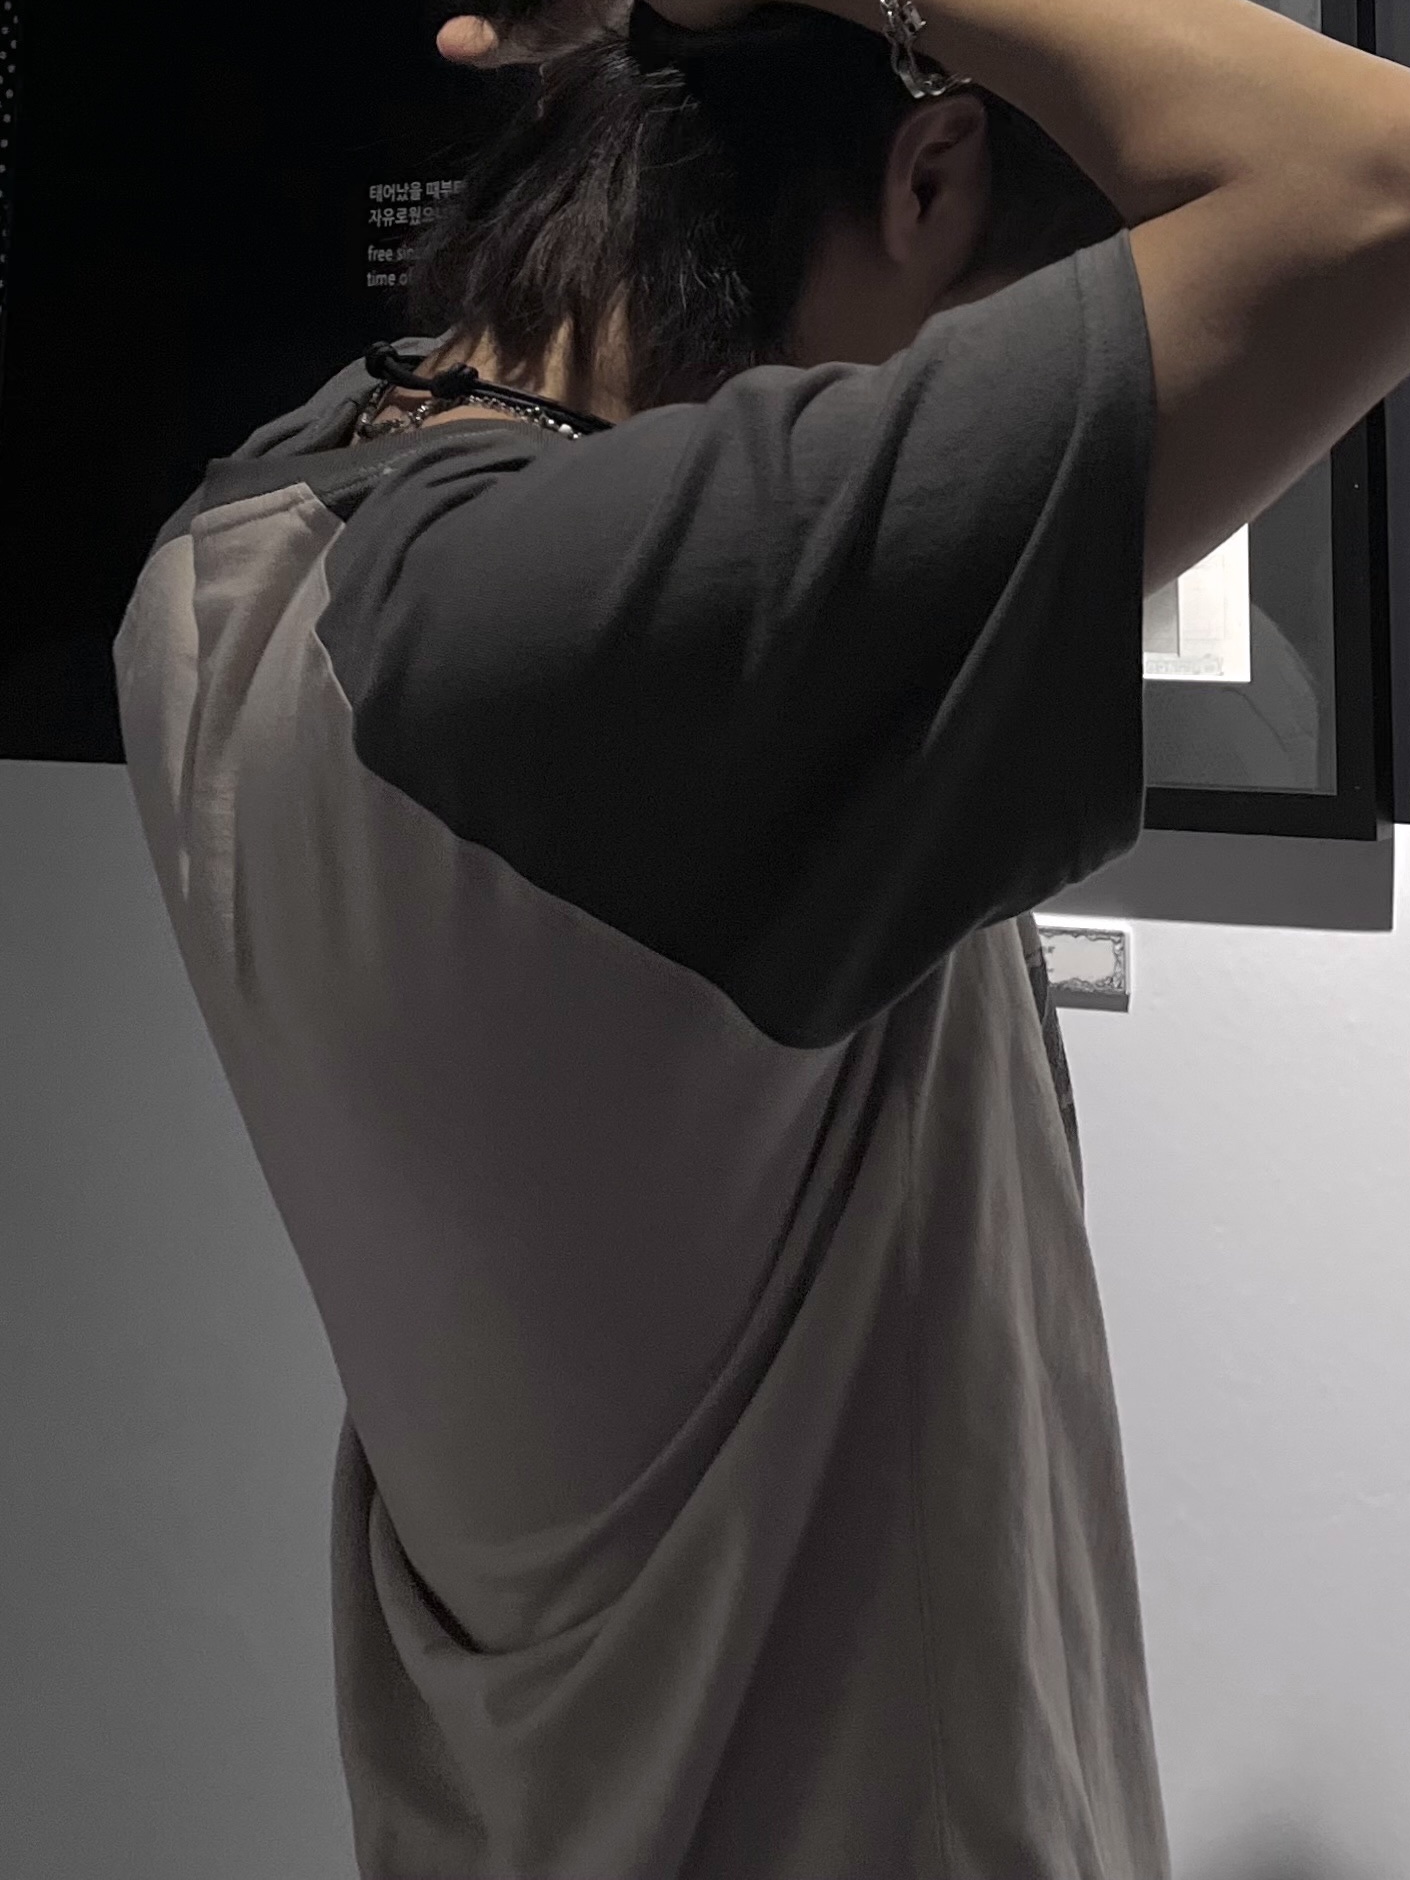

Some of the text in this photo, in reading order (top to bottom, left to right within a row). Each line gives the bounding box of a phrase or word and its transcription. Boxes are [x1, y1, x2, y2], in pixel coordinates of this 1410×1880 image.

[369, 181, 422, 203] 태어났을
[368, 244, 393, 262] free
[367, 270, 396, 287] time
